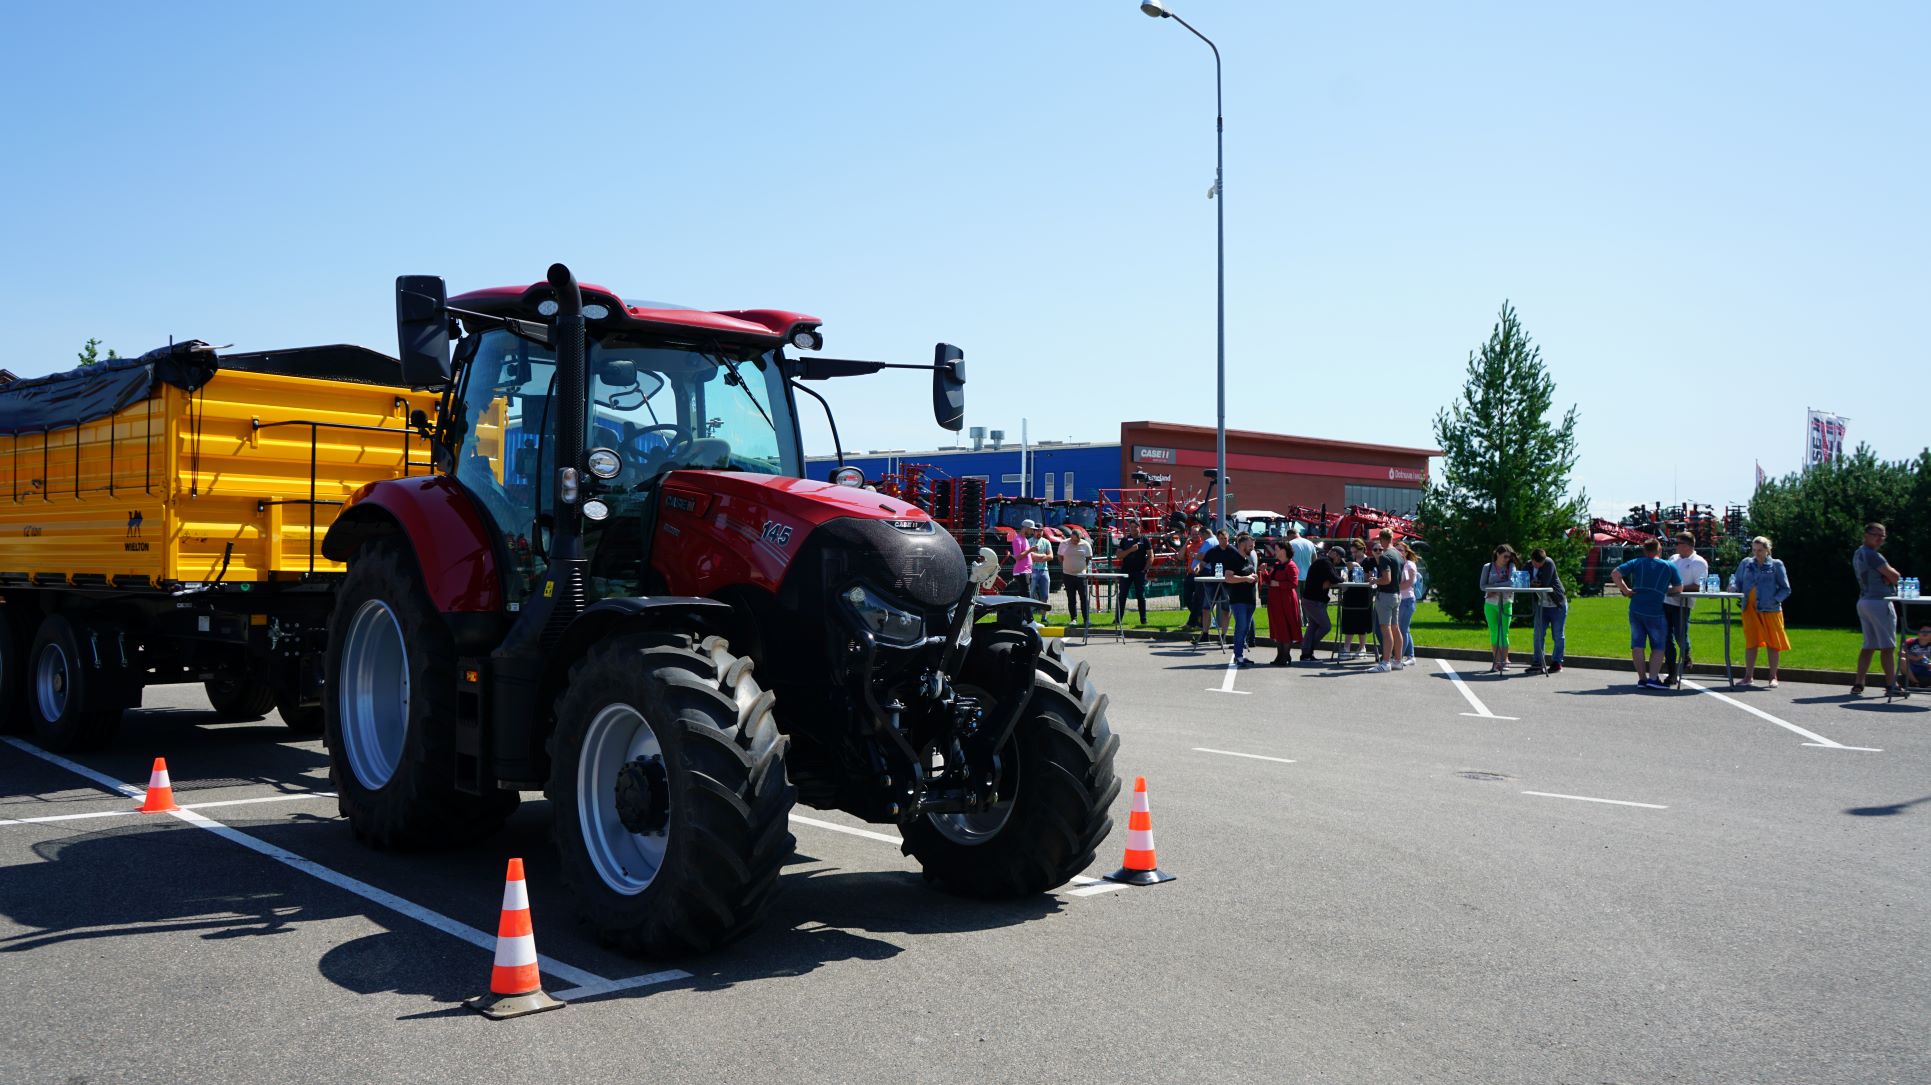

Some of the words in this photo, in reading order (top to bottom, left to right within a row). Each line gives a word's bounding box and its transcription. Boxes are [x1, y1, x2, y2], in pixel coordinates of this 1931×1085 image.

[1141, 449, 1161, 458] CASE
[761, 520, 793, 547] 145
[124, 542, 149, 552] WIELTON
